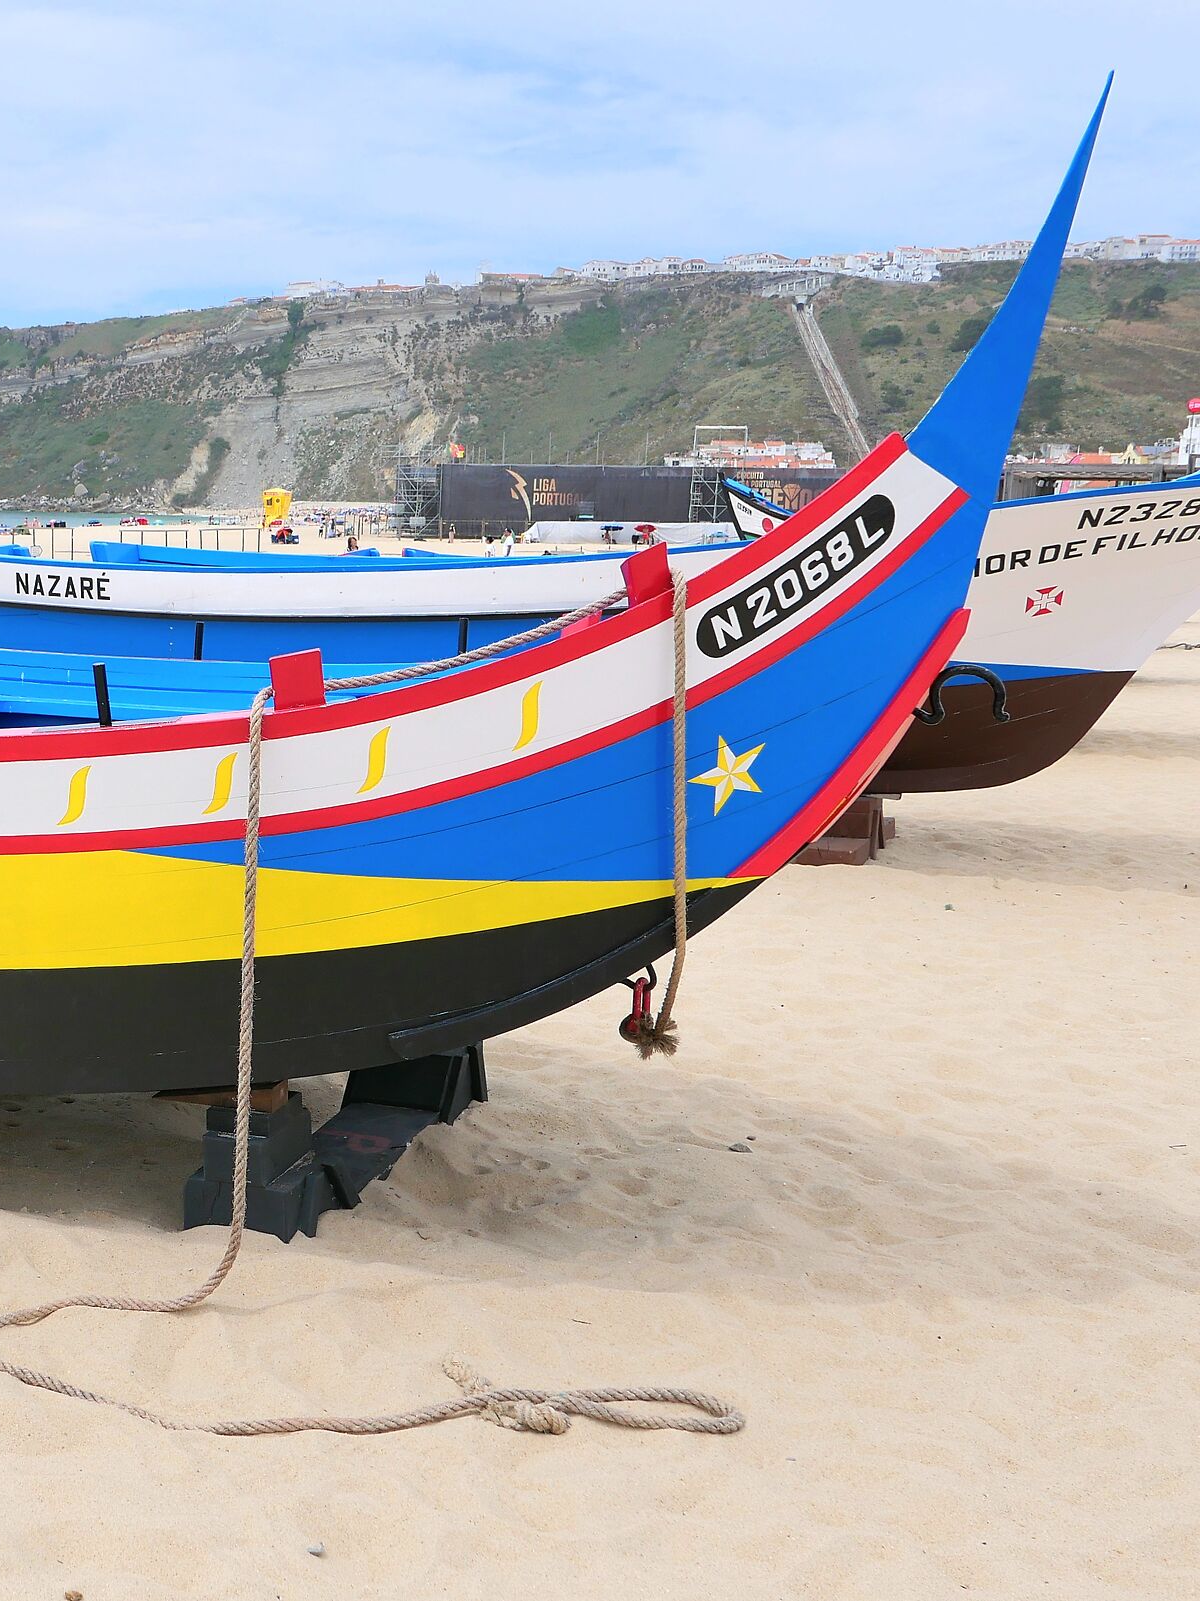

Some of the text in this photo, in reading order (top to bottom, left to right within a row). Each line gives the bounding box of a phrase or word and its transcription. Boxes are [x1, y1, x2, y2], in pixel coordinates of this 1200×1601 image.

[533, 479, 556, 491] LIGA
[751, 480, 781, 488] PORTUGAL
[1077, 498, 1200, 530] N2328
[1038, 539, 1087, 565] DE
[1091, 525, 1200, 555] FILHO
[15, 572, 111, 600] NAZARÉ
[710, 515, 885, 650] N 2068 L
